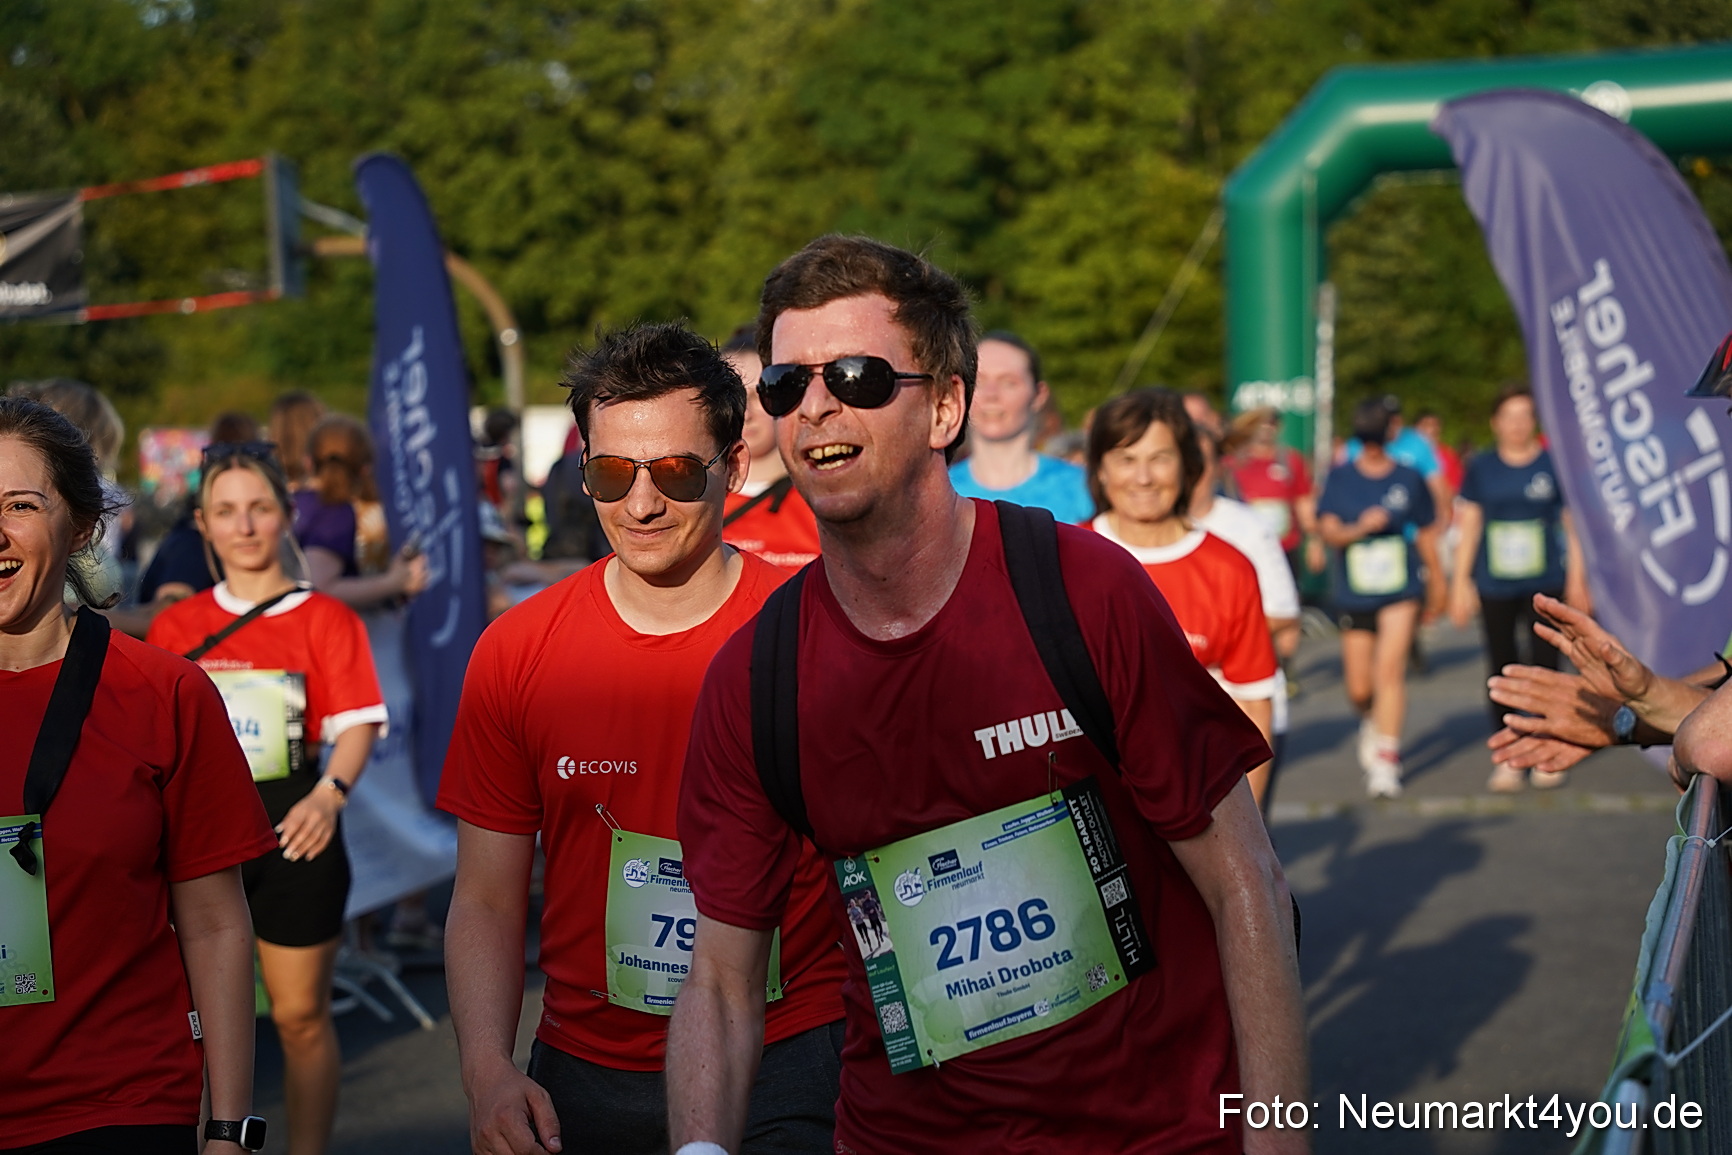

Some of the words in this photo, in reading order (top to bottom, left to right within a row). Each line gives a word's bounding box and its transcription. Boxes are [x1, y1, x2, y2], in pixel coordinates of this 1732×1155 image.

[580, 760, 637, 774] ECOVIS
[1068, 798, 1091, 846] RABATT
[1079, 794, 1096, 829] OUTLET
[1092, 827, 1110, 869] FACTORY
[843, 871, 867, 888] AOK
[926, 860, 985, 891] Firmenlauf
[951, 873, 985, 891] neumarkt
[930, 898, 1057, 971] 2786
[1114, 907, 1139, 966] HILTL
[618, 952, 689, 974] Johannes
[945, 969, 996, 1000] Mihai
[997, 949, 1074, 984] Drobota
[968, 1009, 1033, 1041] firmenlauf.bayern
